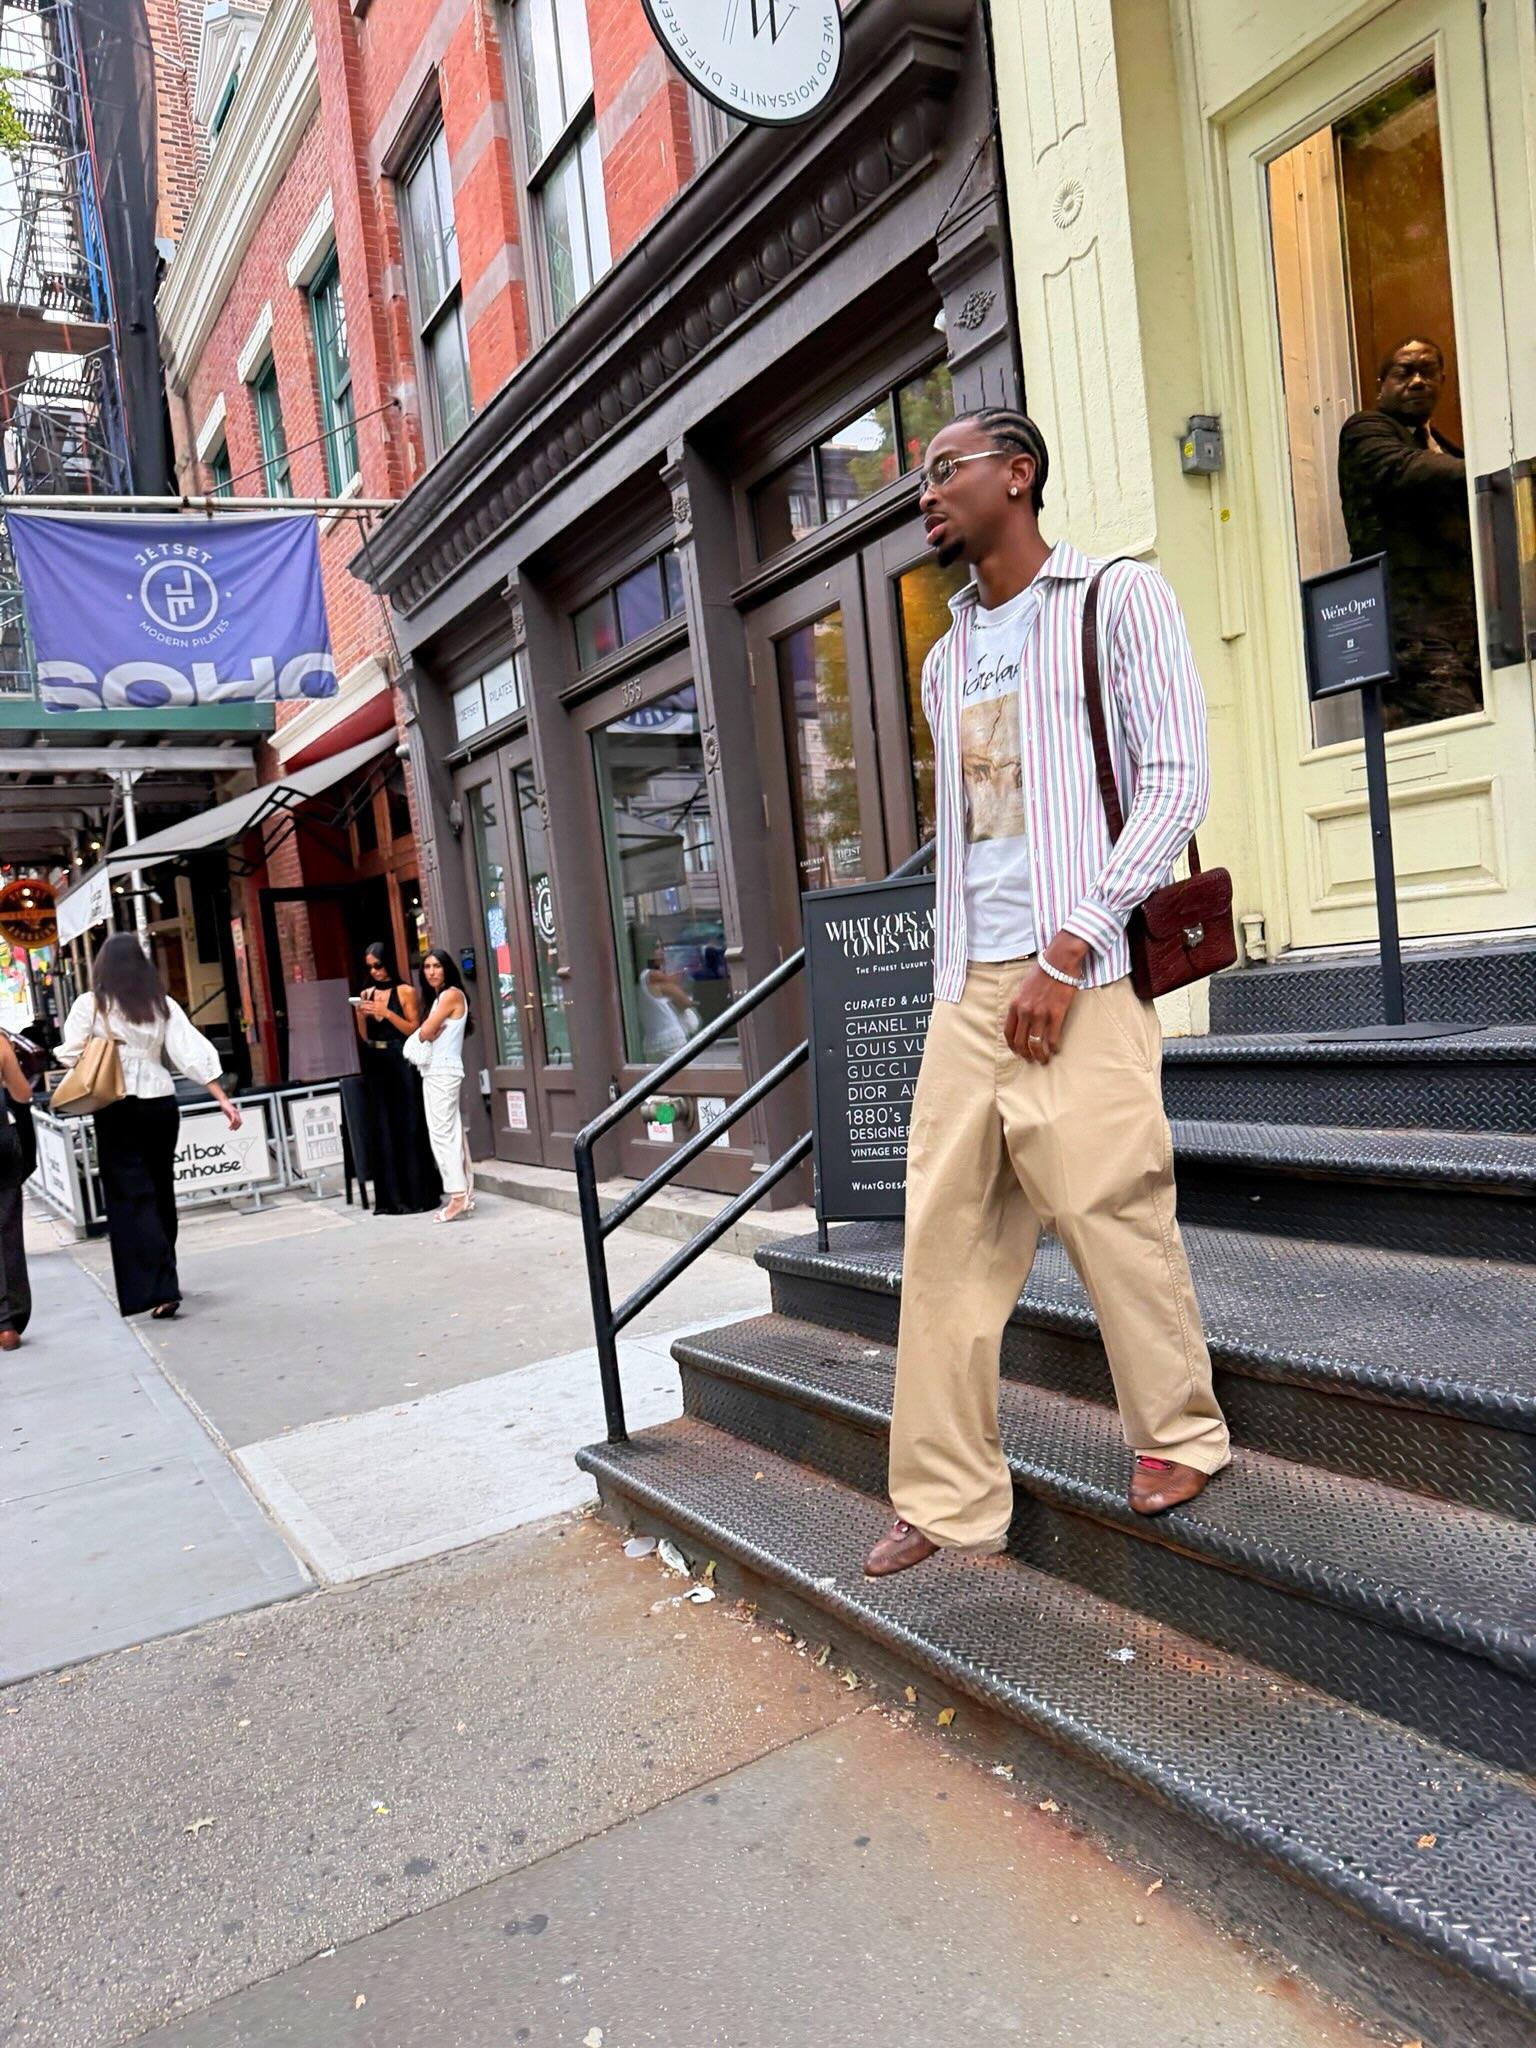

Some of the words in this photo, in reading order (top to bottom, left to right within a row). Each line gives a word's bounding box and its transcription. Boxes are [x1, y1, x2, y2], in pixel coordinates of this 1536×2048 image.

[823, 15, 834, 45] WE
[658, 0, 723, 86] DIFFERE
[816, 50, 831, 76] DO
[730, 75, 820, 108] MOISSANITE
[134, 542, 213, 567] JETSET
[1321, 604, 1348, 621] We're
[1348, 597, 1376, 615] Open
[139, 620, 189, 648] MODERN
[192, 618, 230, 648] PILATES
[37, 653, 339, 714] SOHO
[825, 917, 871, 942] WHAT
[874, 910, 918, 935] GOES
[843, 934, 900, 958] COMES
[902, 928, 936, 951] ARO
[844, 997, 896, 1011] CURATED
[901, 996, 908, 1006] &
[912, 993, 935, 1004] AUT
[845, 1018, 908, 1036] CHANEL
[846, 1040, 897, 1058] LOUIS
[903, 1038, 925, 1053] VU
[847, 1062, 907, 1079] GUCCI
[848, 1085, 886, 1101] DIOR
[846, 1107, 901, 1125] 1880's
[173, 1144, 192, 1164] arl
[194, 1143, 226, 1160] box
[851, 1147, 890, 1157] VINTAGE
[893, 1146, 908, 1155] RO
[852, 1180, 907, 1191] WHATGOESA
